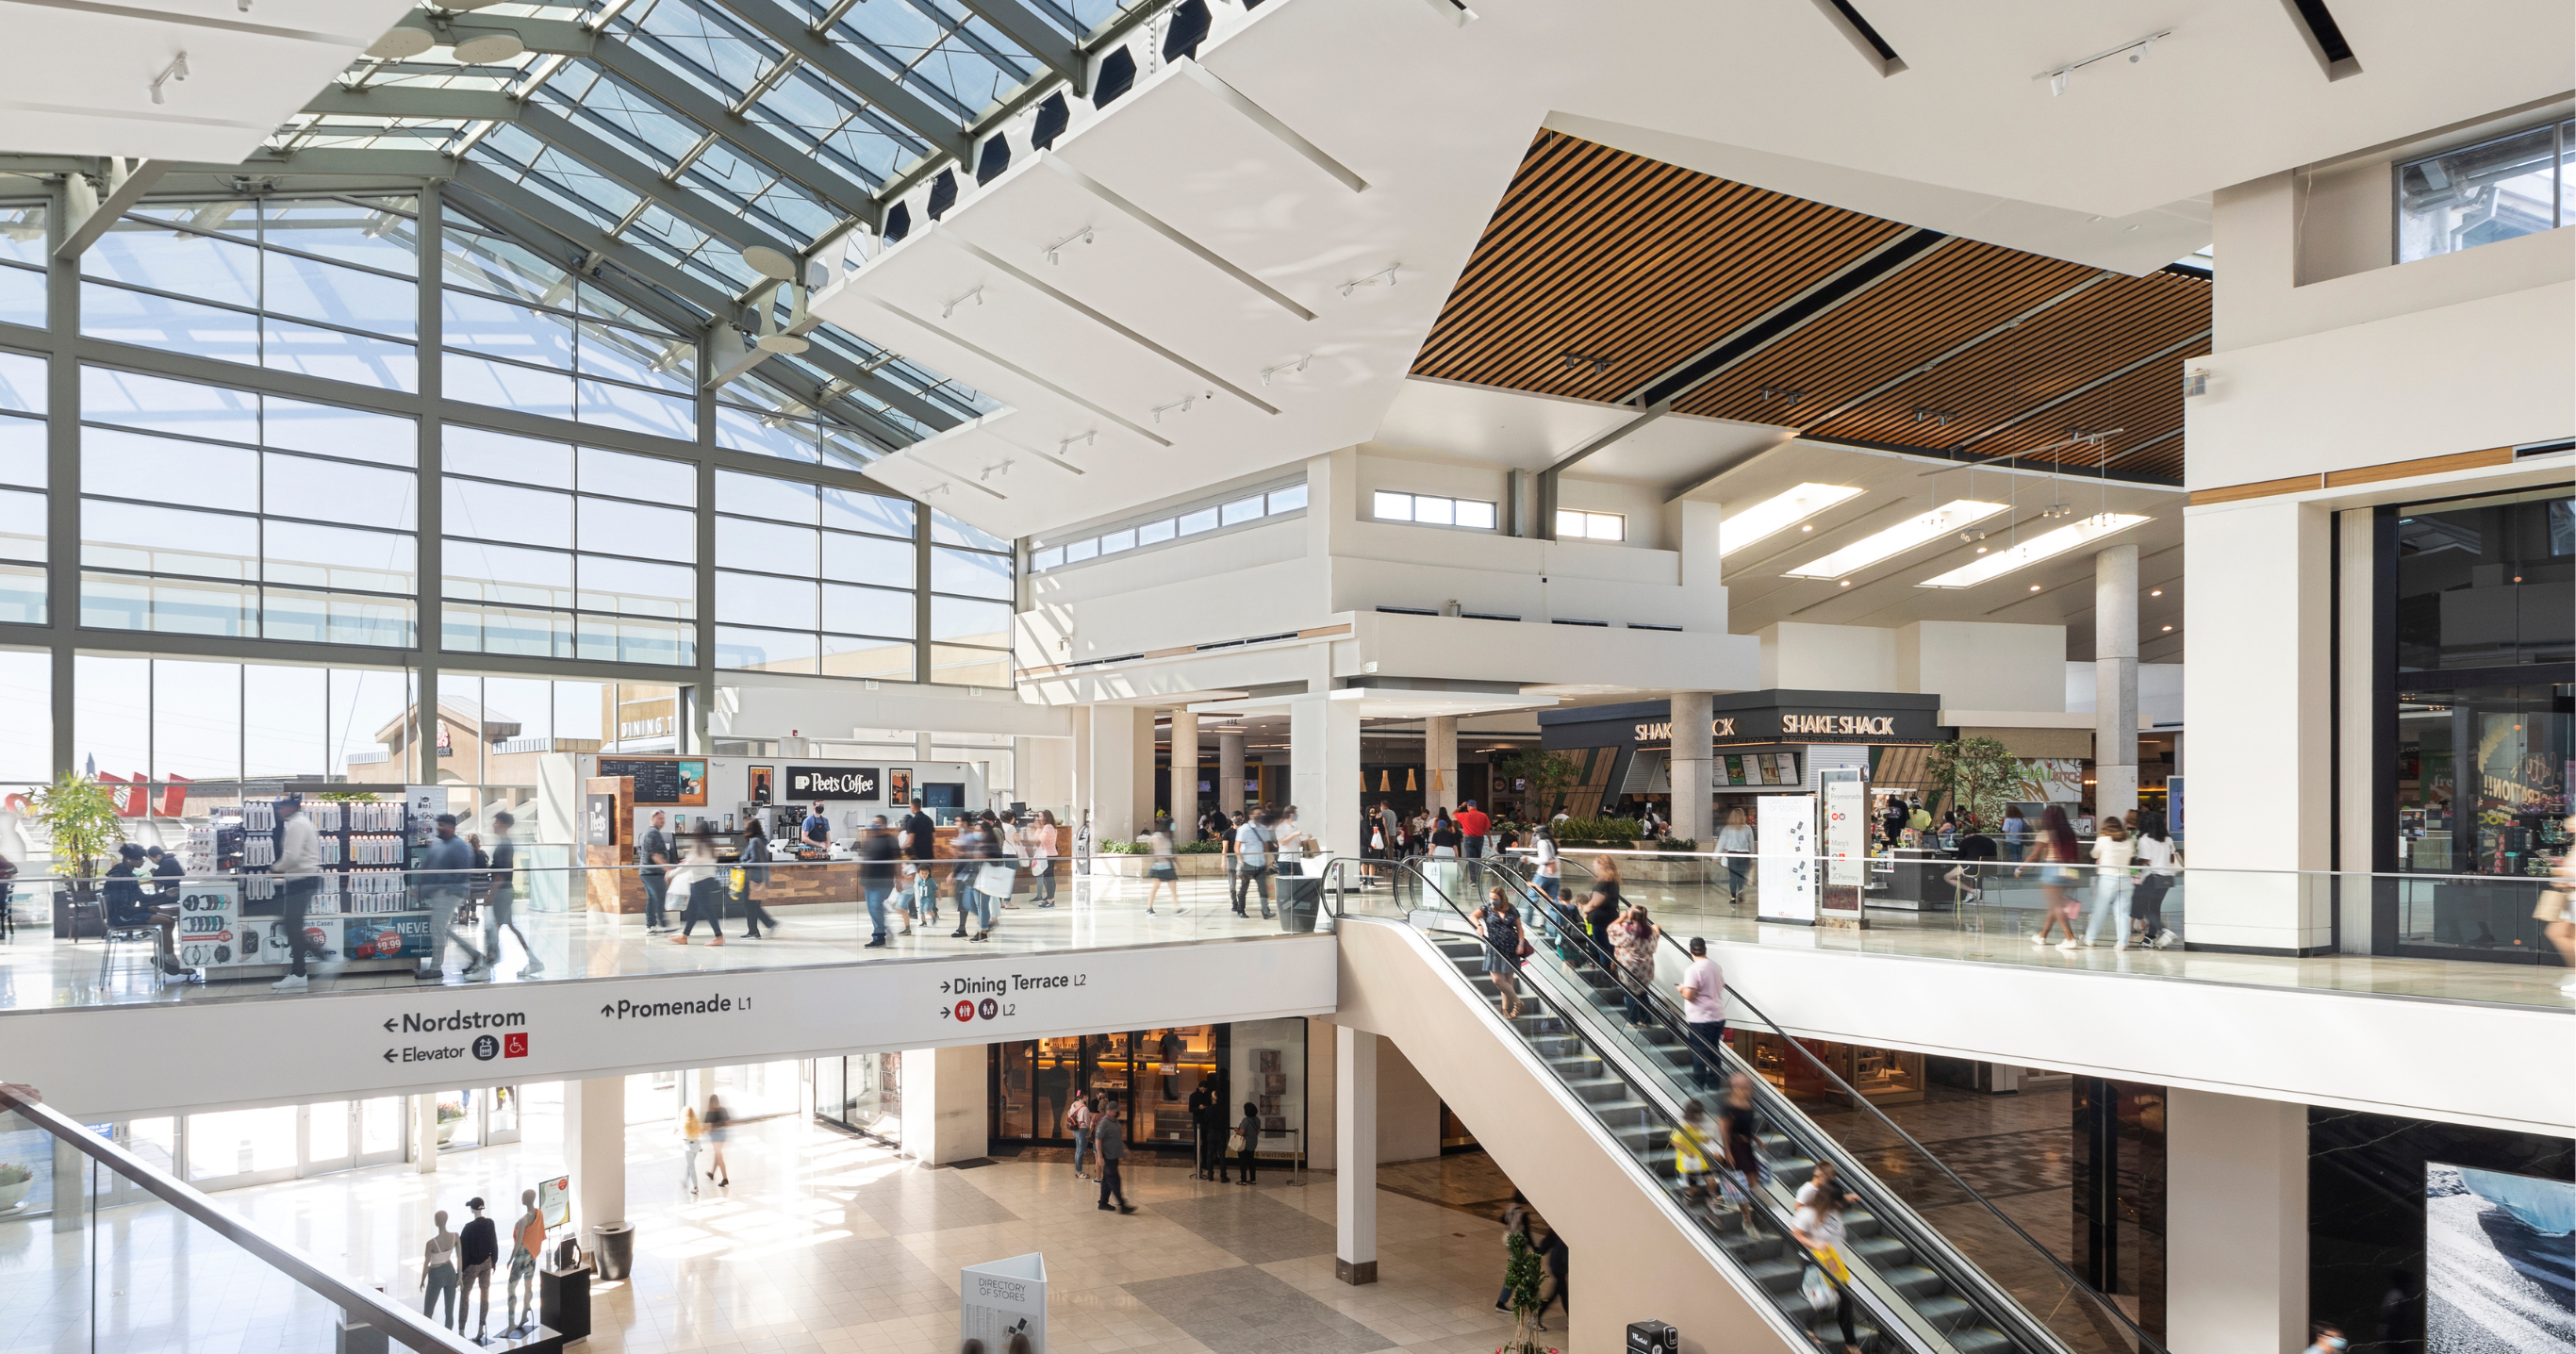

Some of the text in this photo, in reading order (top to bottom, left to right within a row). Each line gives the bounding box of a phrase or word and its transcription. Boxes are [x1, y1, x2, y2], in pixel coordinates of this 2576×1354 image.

[620, 716, 664, 737] DINING
[1634, 721, 1672, 741] SHAK
[1782, 715, 1894, 735] SHAKE SHACK
[811, 772, 840, 793] Peet's
[841, 774, 874, 794] Coffee
[1830, 839, 1849, 848] Macy's
[1830, 873, 1859, 883] JCPenney
[377, 939, 402, 950] $9.99
[954, 973, 1086, 997] Dining Terrace L2
[618, 993, 751, 1019] Promenade L1
[1002, 1003, 1016, 1016] L2
[403, 1009, 526, 1033] Nordstrom
[403, 1044, 466, 1063] Elevator
[978, 1277, 1027, 1293] DIRECTORY
[979, 1286, 1026, 1302] OF STORES
